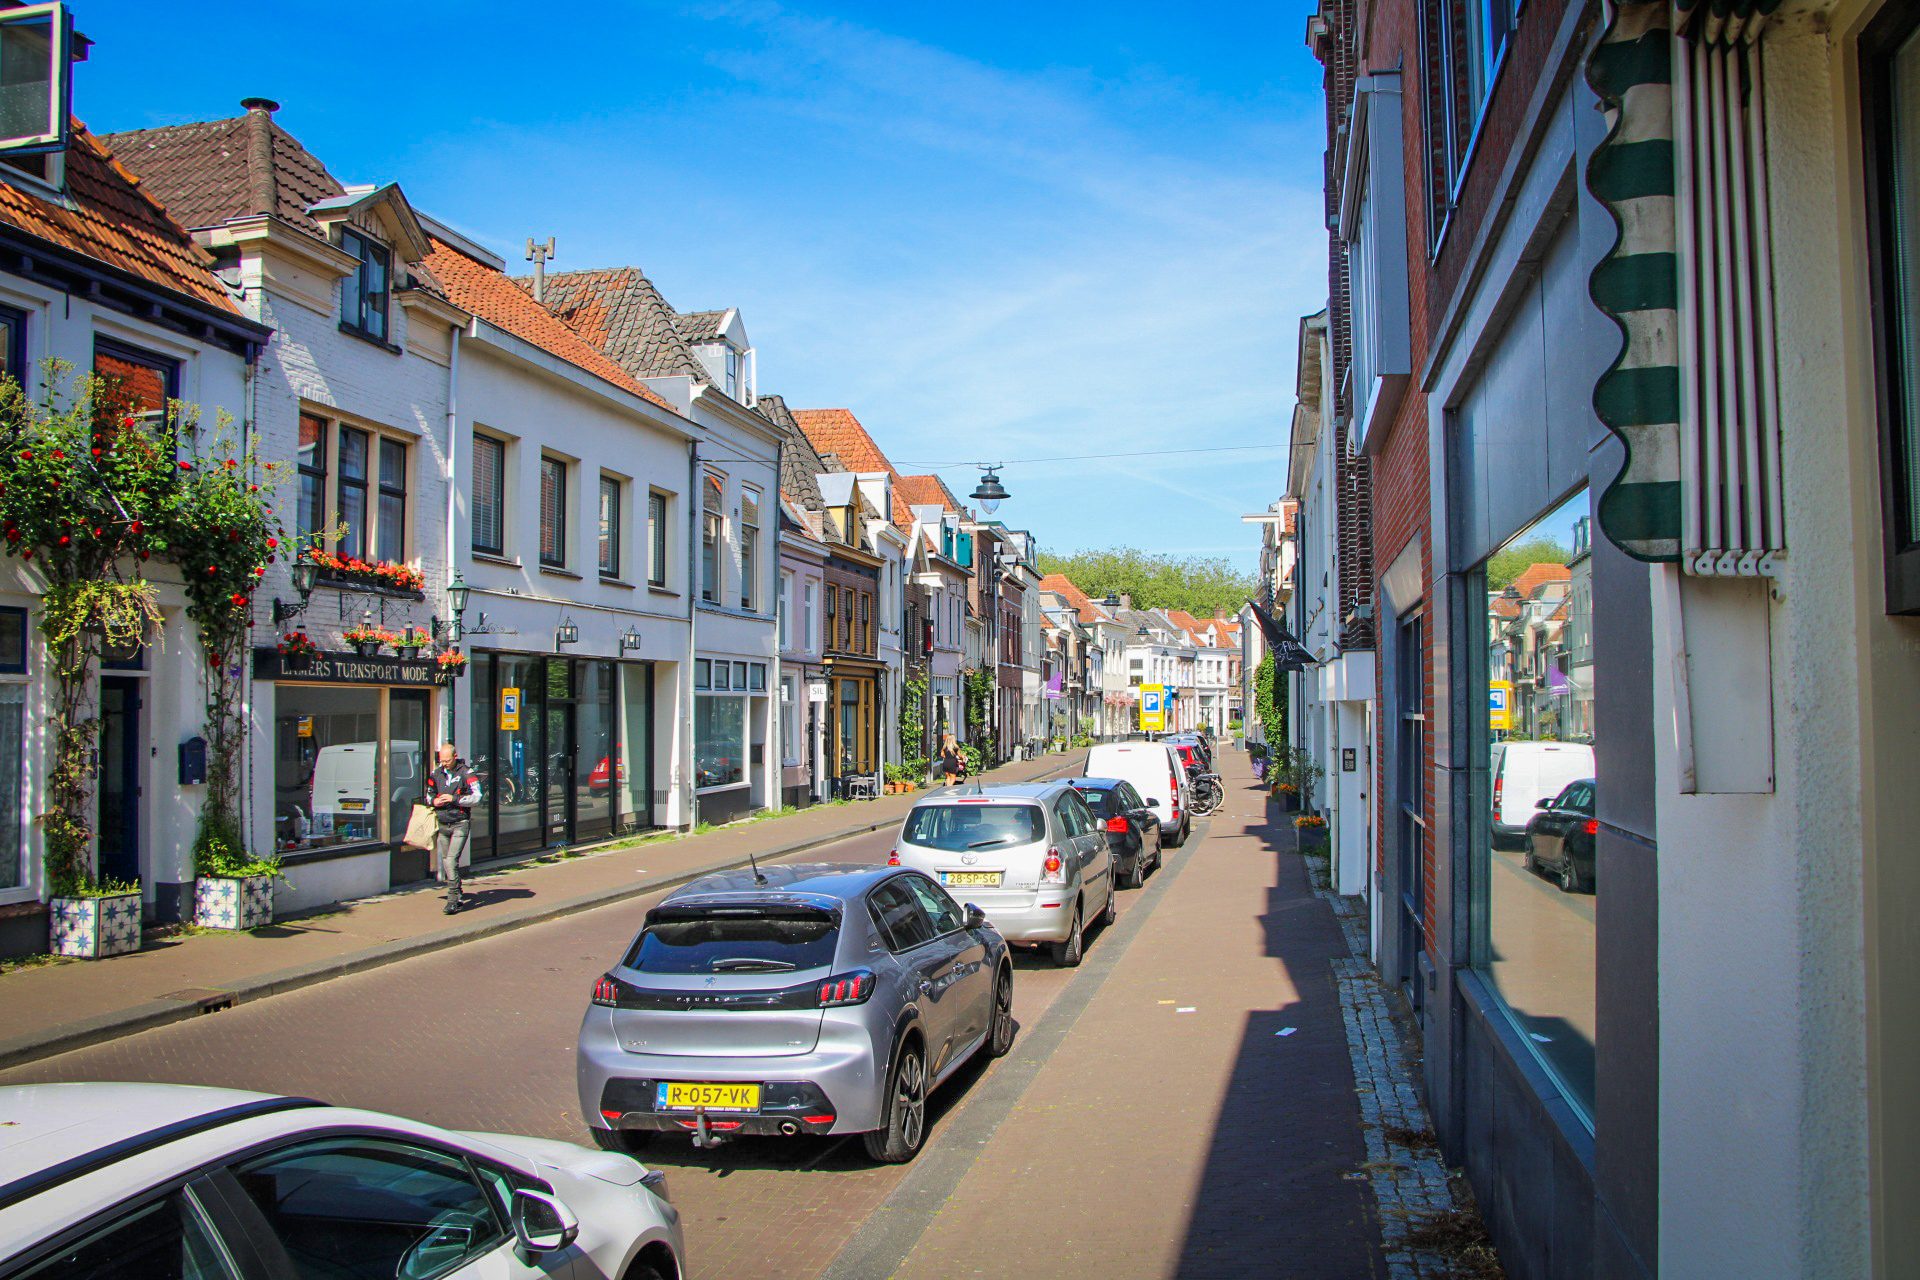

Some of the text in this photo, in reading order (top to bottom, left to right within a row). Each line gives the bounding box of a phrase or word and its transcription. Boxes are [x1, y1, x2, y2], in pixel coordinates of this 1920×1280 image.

[335, 662, 399, 681] TURNSPORT
[401, 666, 429, 682] MODE
[812, 687, 824, 695] SIL
[1146, 694, 1158, 708] P
[950, 874, 996, 884] 28-SP-SG
[672, 1087, 750, 1104] R-057-VK
